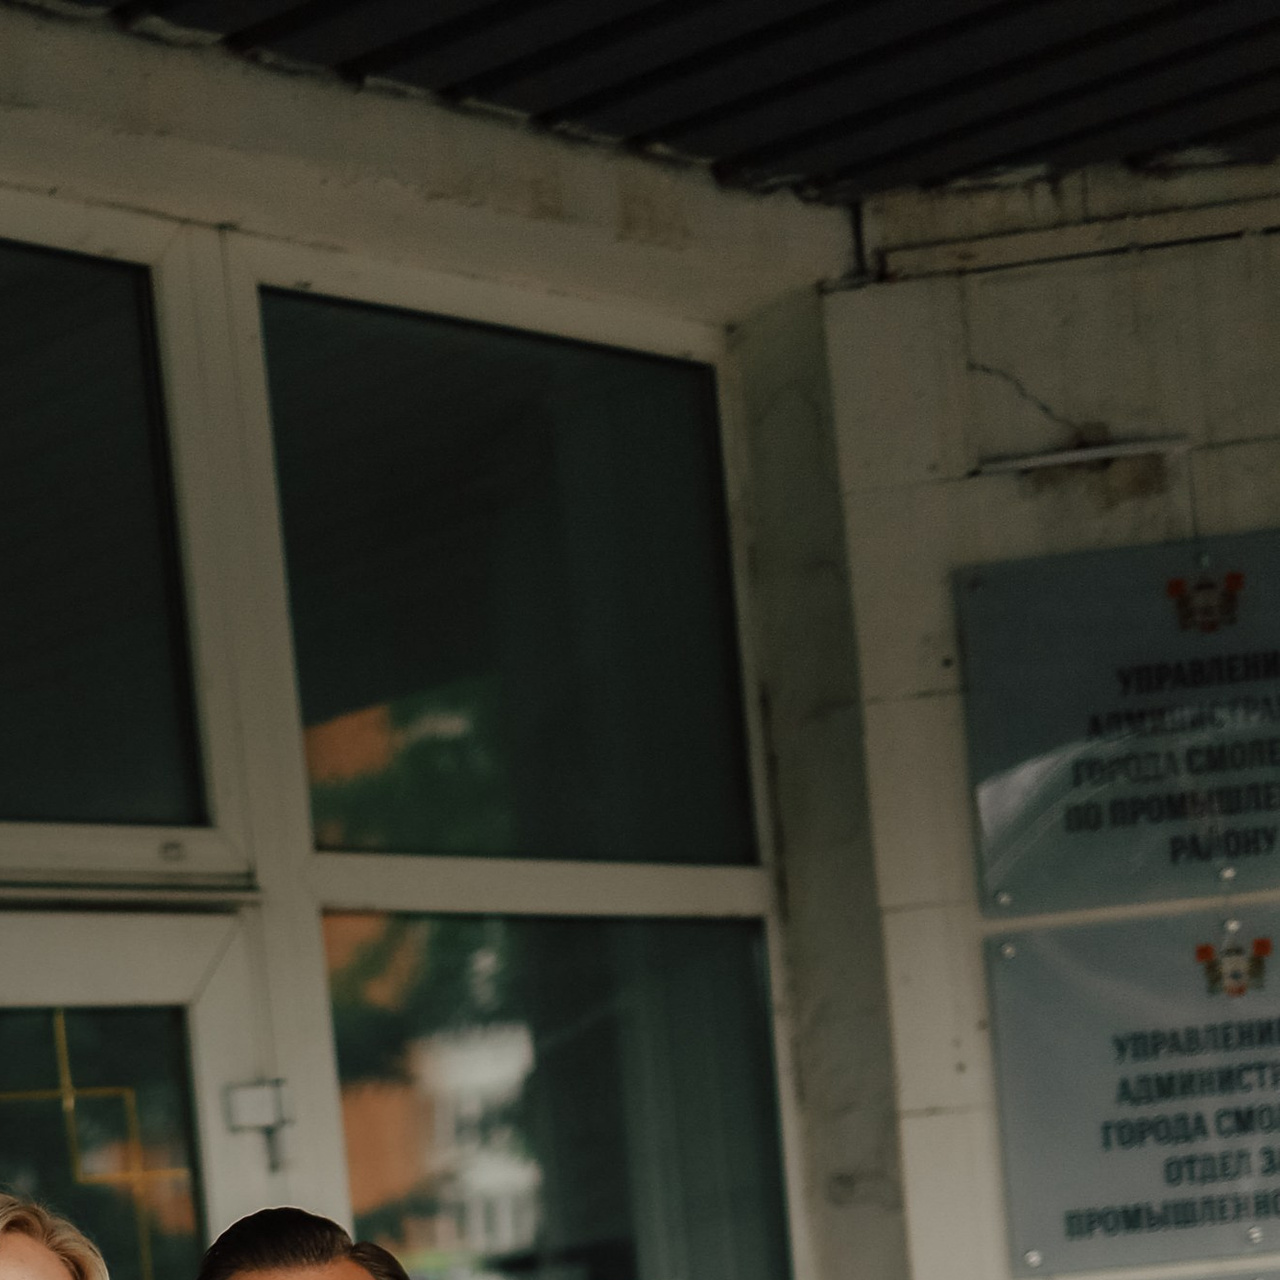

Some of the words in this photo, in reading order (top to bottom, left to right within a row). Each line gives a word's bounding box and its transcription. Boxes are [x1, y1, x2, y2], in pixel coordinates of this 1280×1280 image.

[1111, 1016, 1280, 1064] УПРАВЛЕНИ
[1101, 1110, 1209, 1152] ГОРОДА
[1215, 1102, 1280, 1139] СМО
[1163, 1147, 1252, 1187] ОТДЕЛ
